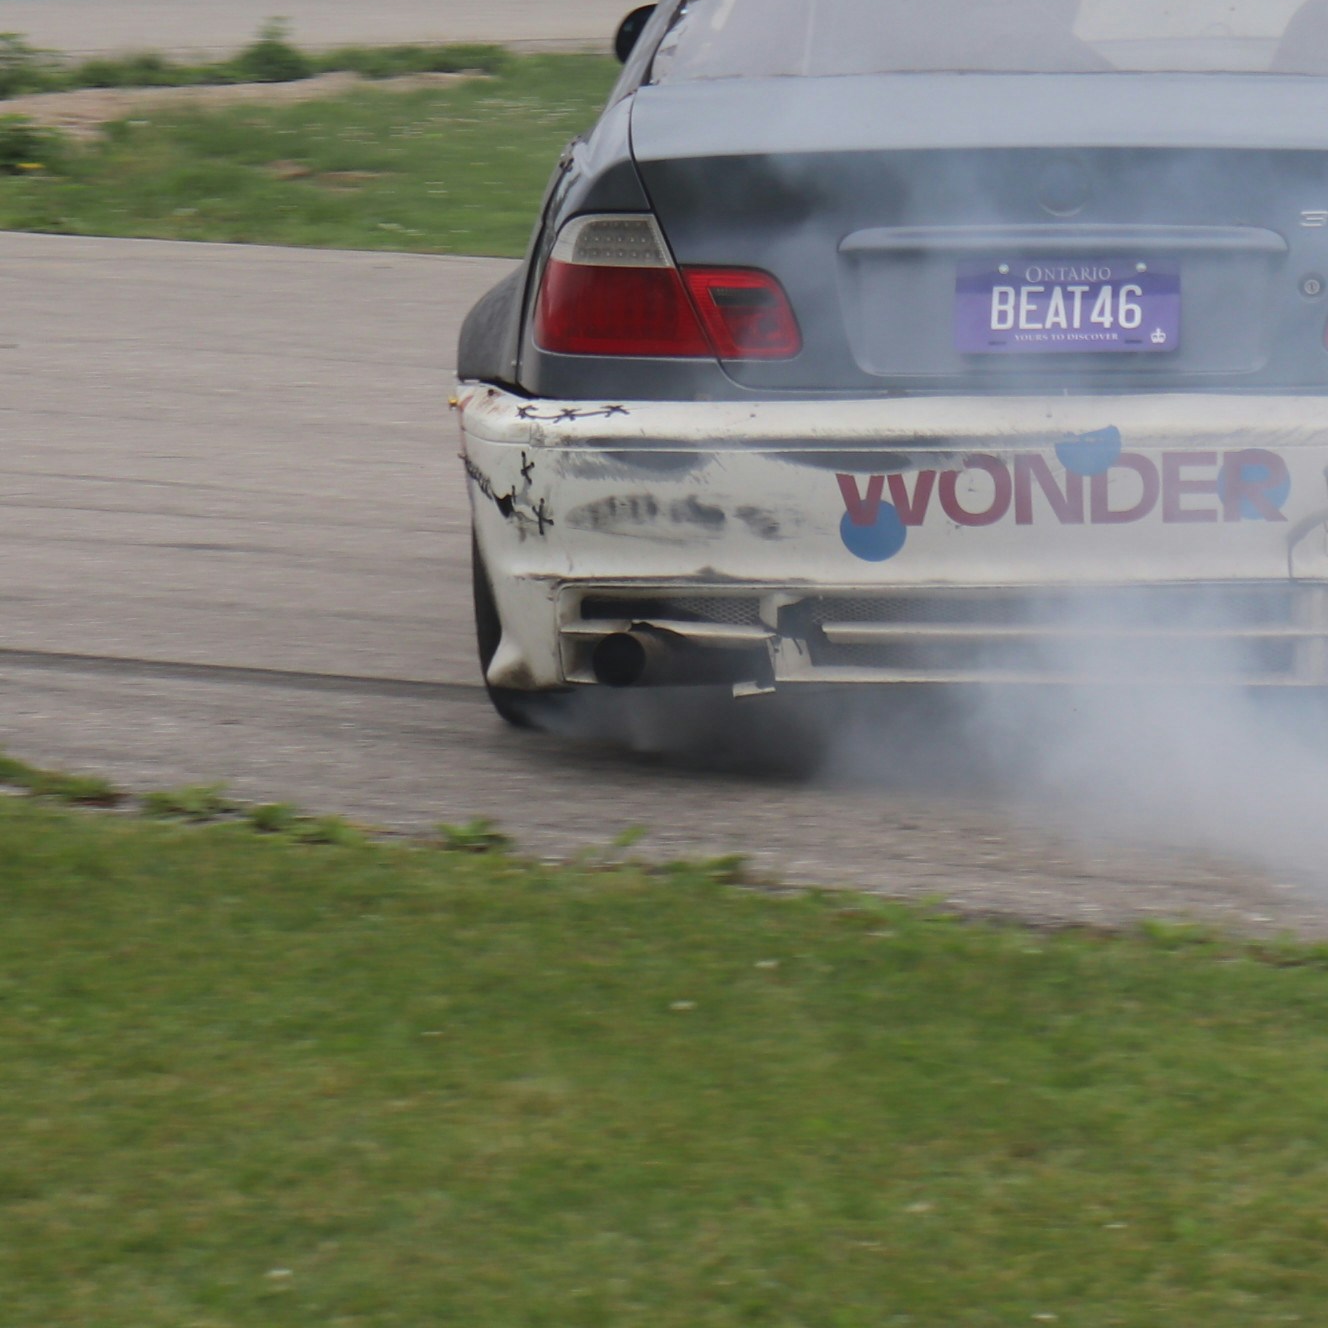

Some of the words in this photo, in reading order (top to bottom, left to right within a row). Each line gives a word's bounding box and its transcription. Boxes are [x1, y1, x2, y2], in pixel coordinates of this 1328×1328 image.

[1025, 266, 1111, 283] ONTARIO
[990, 284, 1143, 330] BEAT46
[1014, 333, 1048, 341] YOURS
[1051, 333, 1065, 341] TO
[1067, 332, 1119, 341] DISCOVER
[835, 449, 1289, 527] WONDER
